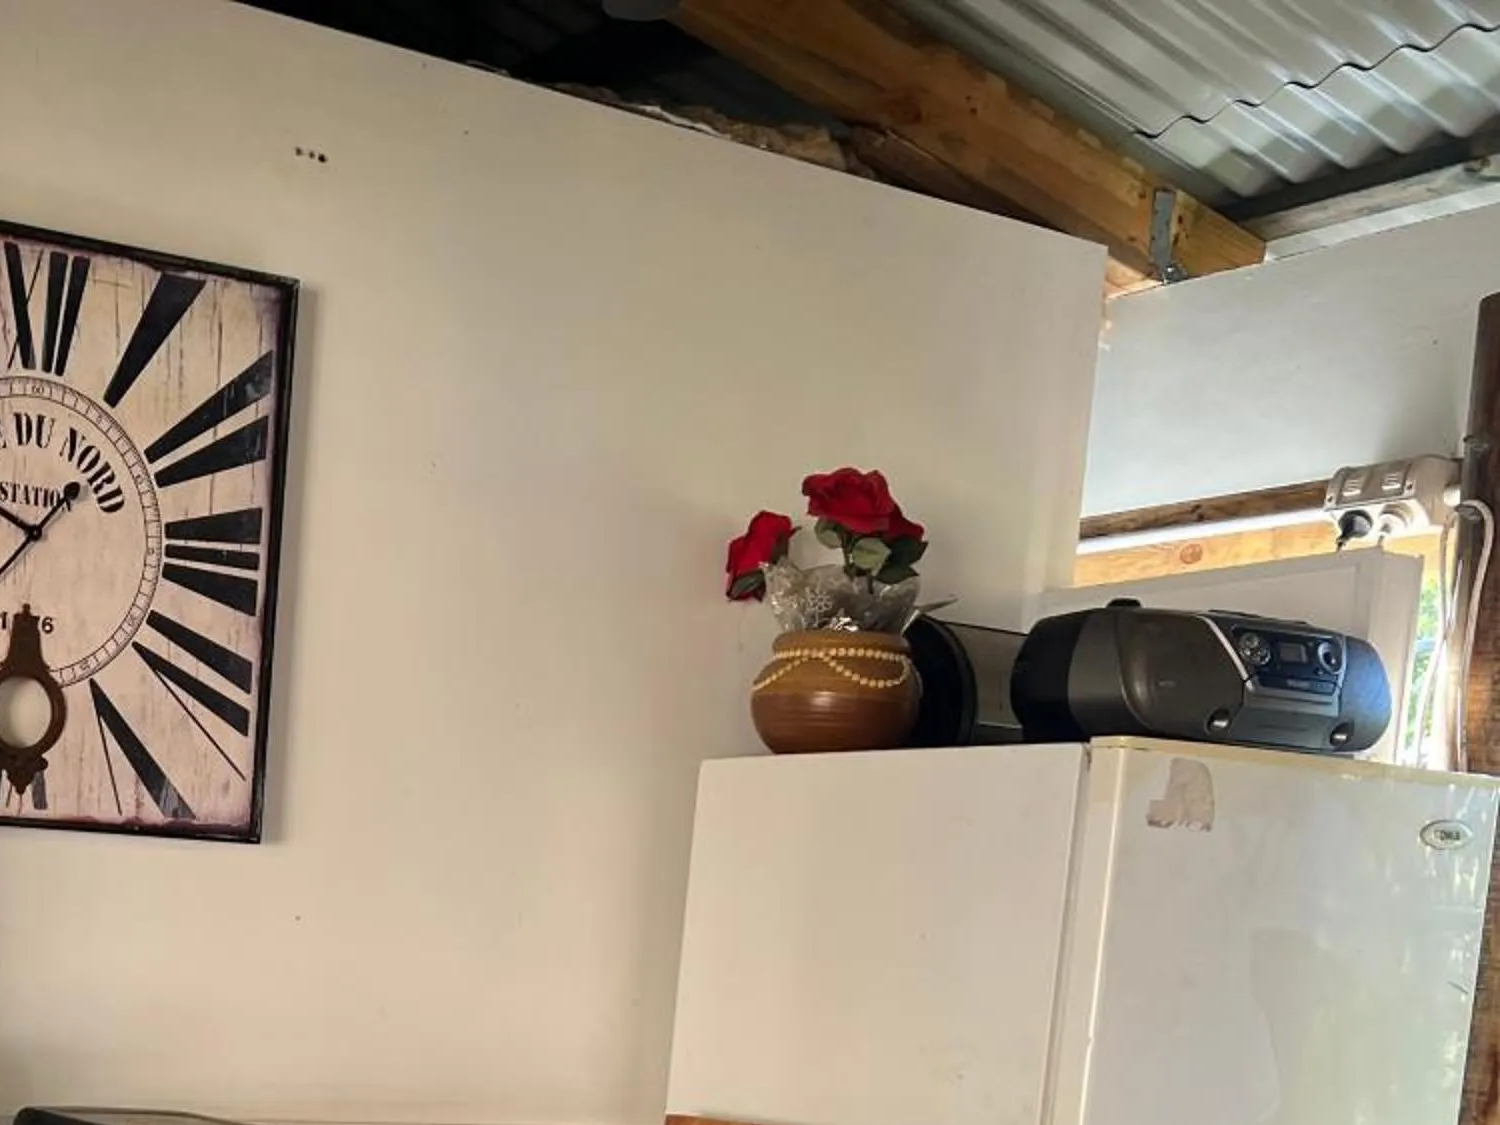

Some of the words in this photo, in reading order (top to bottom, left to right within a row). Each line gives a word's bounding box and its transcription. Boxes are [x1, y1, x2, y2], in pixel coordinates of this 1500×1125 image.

[13, 412, 56, 449] DU
[59, 427, 125, 513] NORD
[0, 611, 54, 635] 16
